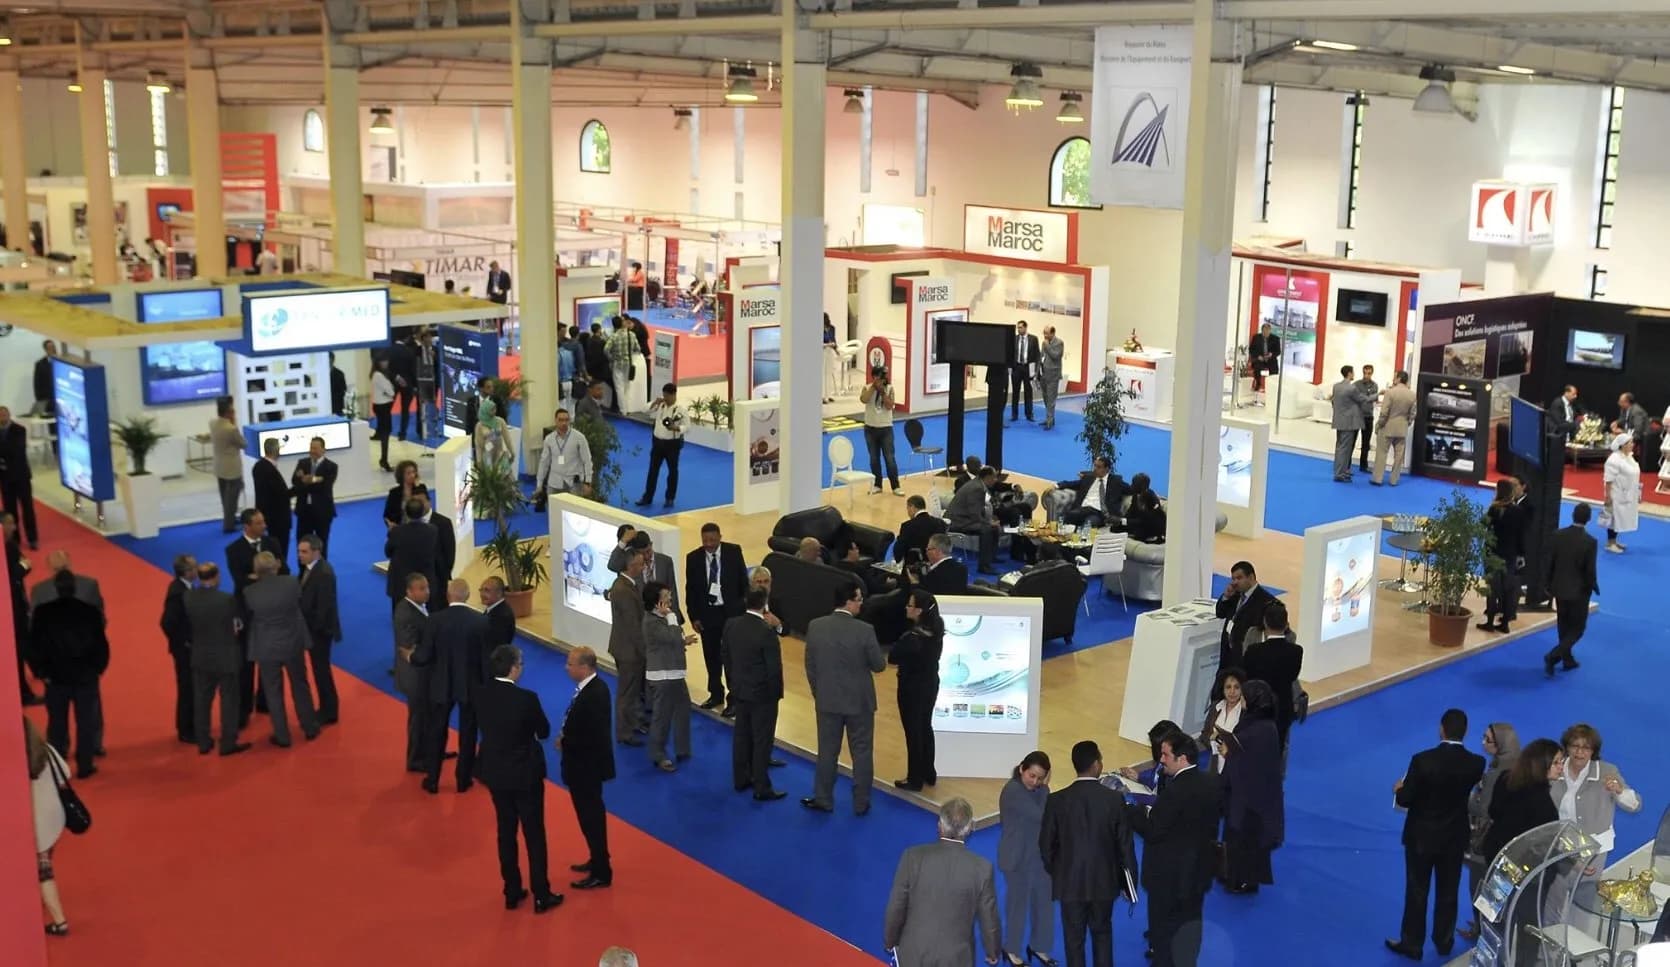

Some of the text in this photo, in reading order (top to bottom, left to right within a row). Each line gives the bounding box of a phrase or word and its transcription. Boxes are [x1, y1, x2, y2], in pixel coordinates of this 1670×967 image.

[988, 215, 1043, 237] Marsa
[987, 231, 1043, 251] Maroc
[425, 256, 485, 274] TIMAR
[919, 285, 949, 294] Marsa
[919, 292, 949, 302] Maroc
[740, 299, 776, 309] Marsa
[740, 307, 776, 318] Maroc
[1455, 313, 1475, 327] ONCF
